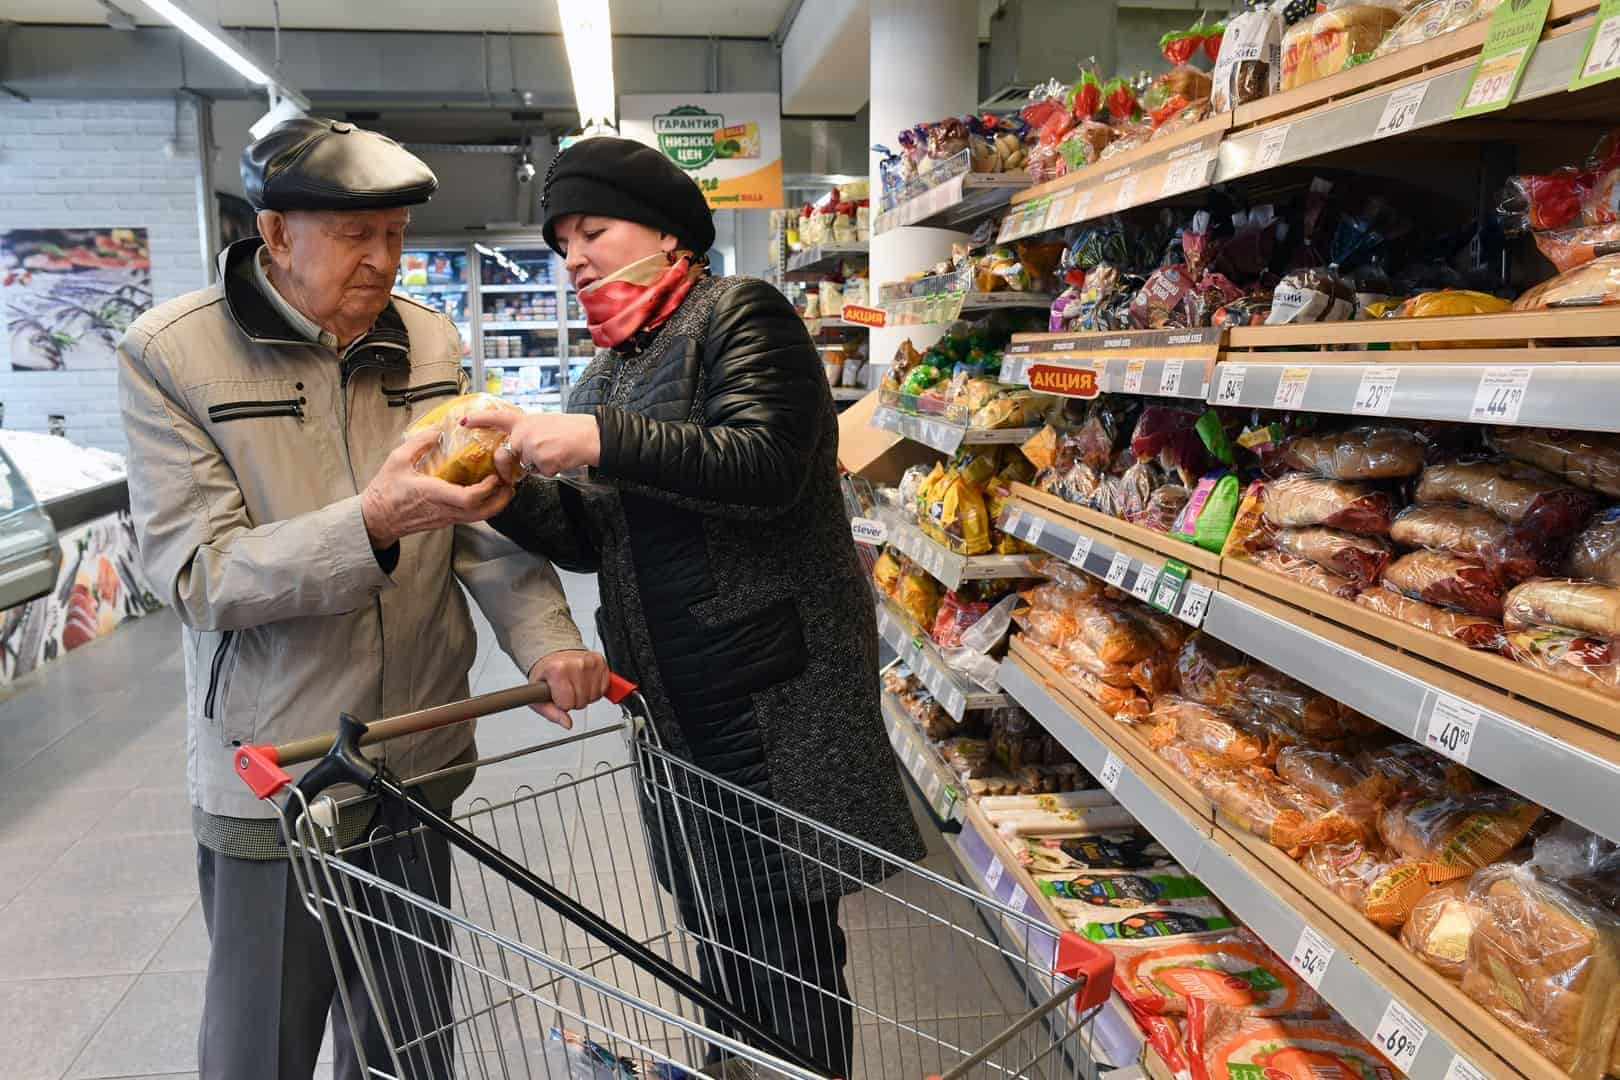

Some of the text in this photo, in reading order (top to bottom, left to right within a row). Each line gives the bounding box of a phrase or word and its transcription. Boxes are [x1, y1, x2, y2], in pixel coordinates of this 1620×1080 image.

[658, 119, 719, 129] ГАРАНТИЯ
[665, 136, 714, 147] НИЗКИХ
[678, 149, 703, 161] ЦЕН
[845, 309, 883, 324] АКЦИЯ
[1033, 371, 1093, 390] АКЦИЯ
[1487, 388, 1510, 416] 44
[852, 524, 882, 538] clever
[1440, 723, 1459, 751] 40
[1301, 948, 1317, 975] 54
[1386, 1029, 1406, 1057] 69
